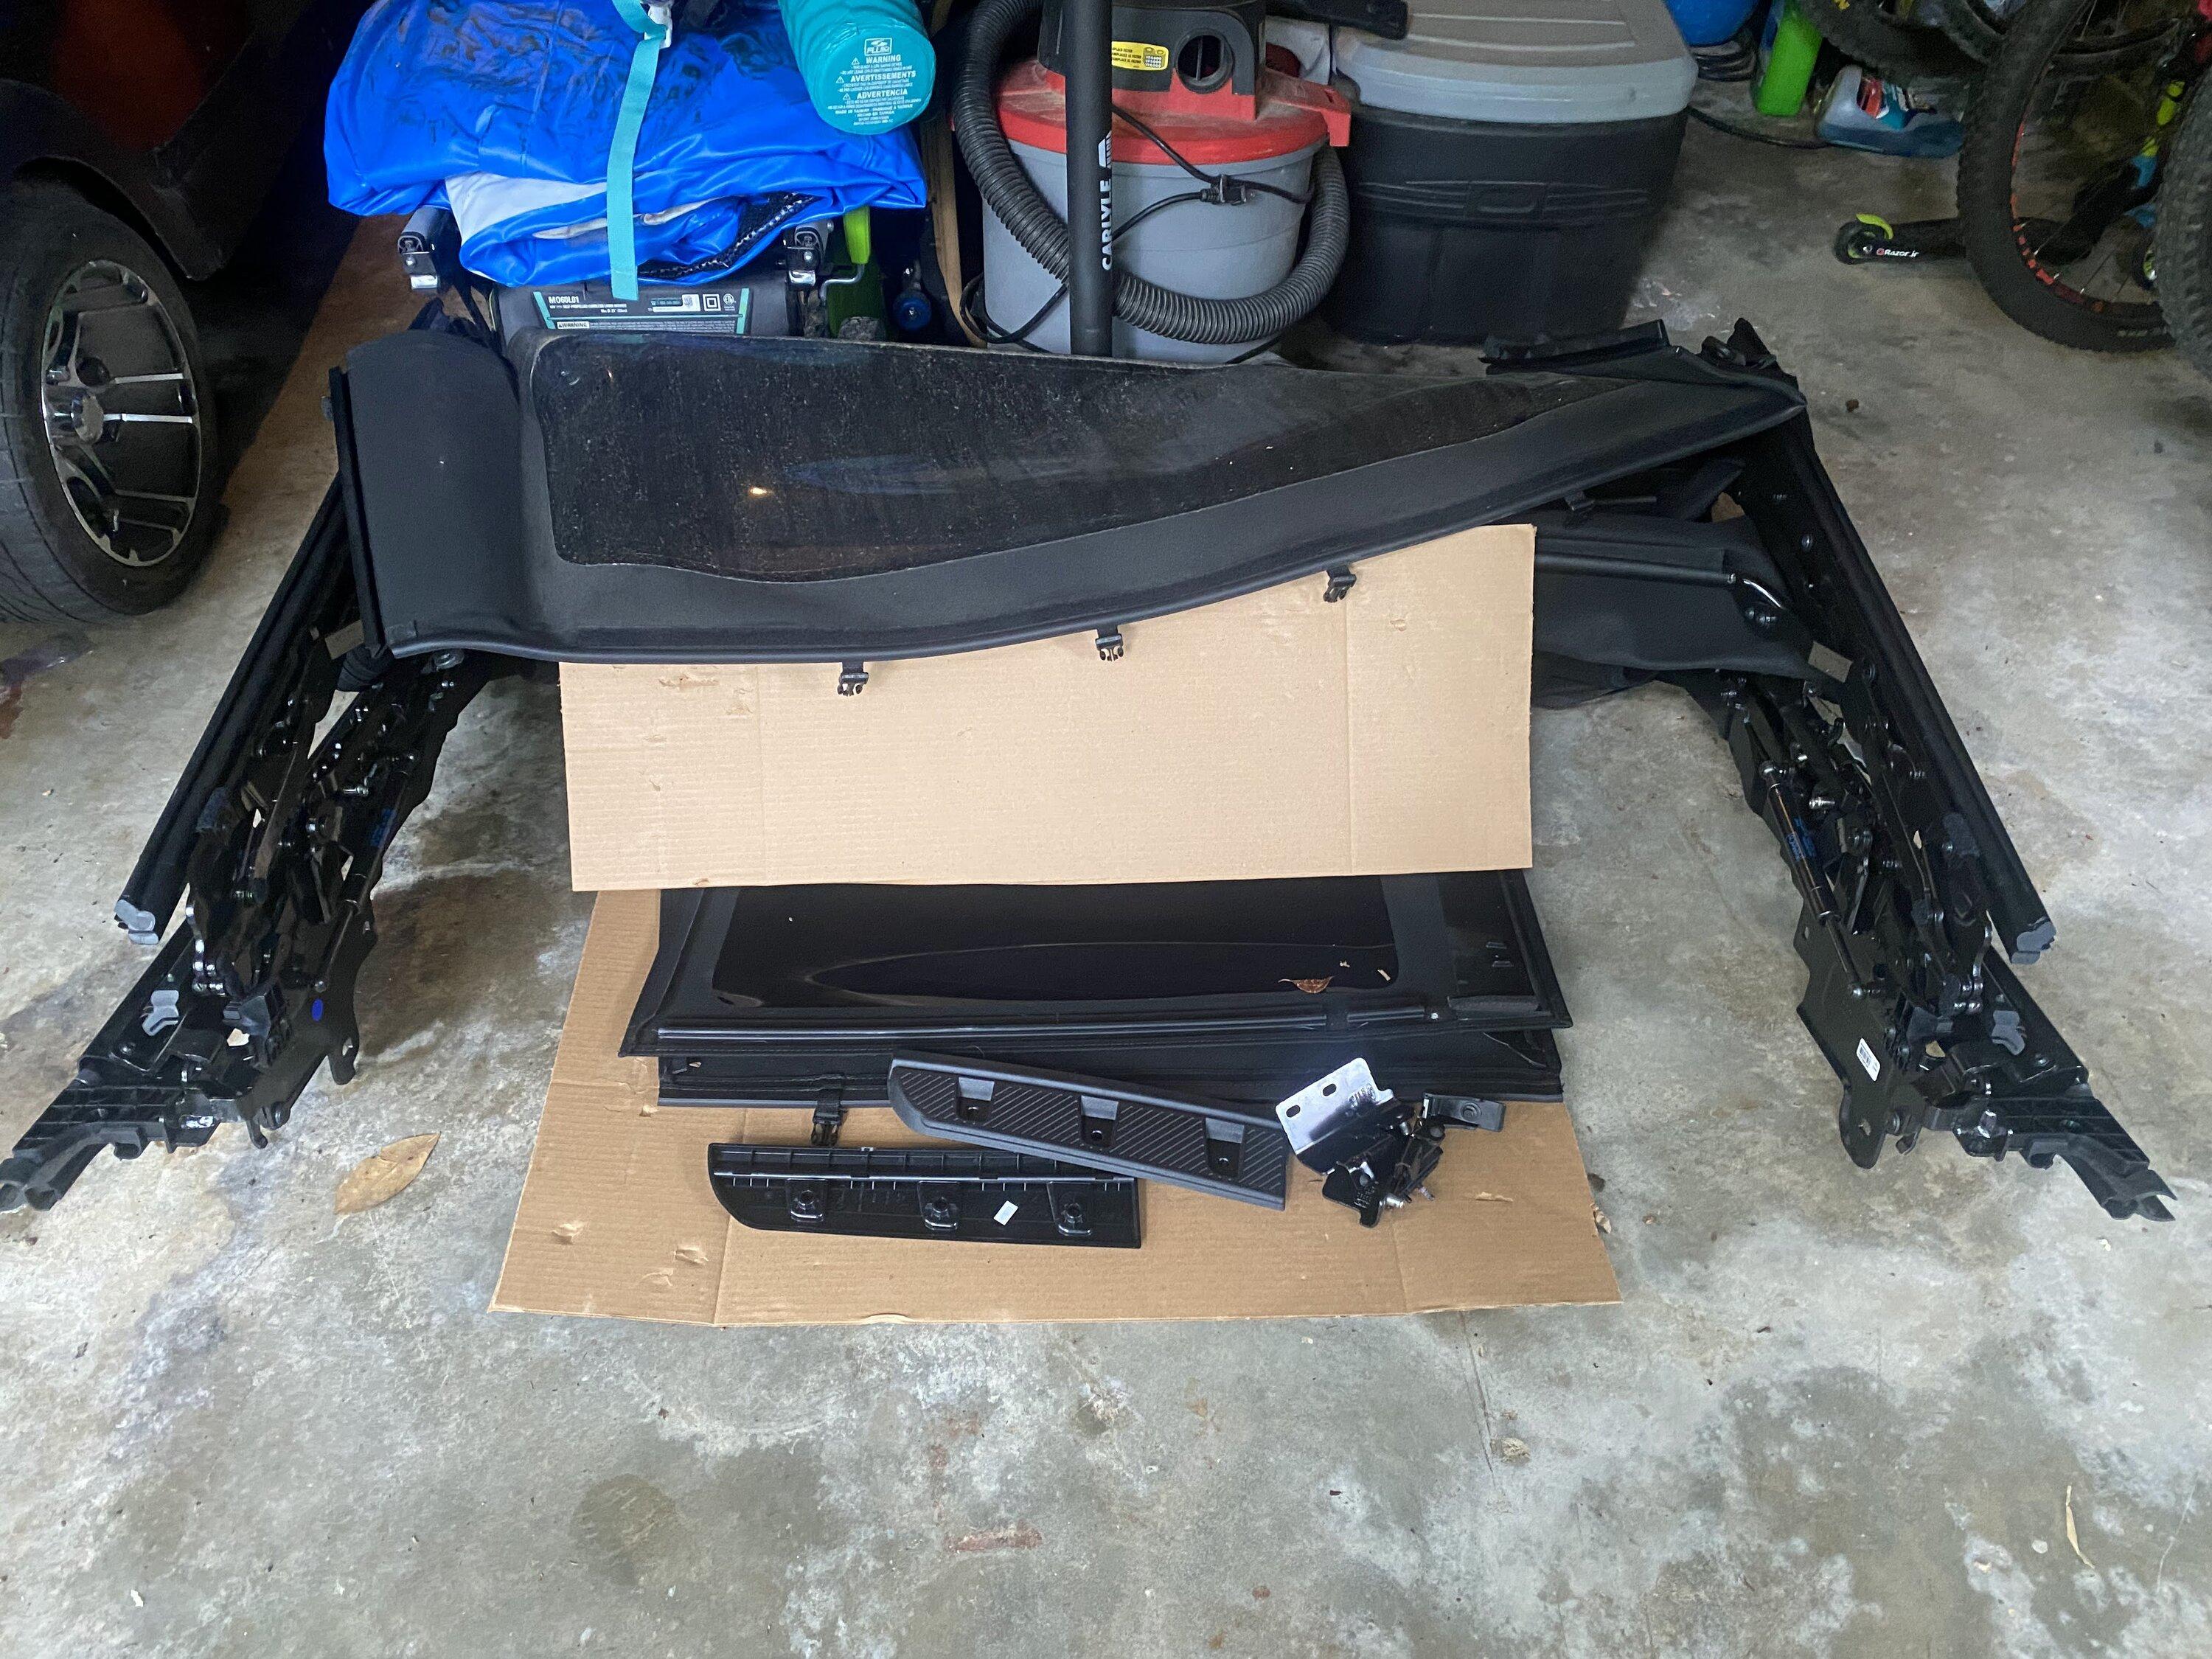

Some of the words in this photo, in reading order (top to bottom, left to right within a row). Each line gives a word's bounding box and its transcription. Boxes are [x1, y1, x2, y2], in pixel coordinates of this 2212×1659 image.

[866, 54, 901, 64] WARNING
[850, 70, 917, 83] AVERTISSEMENTS
[857, 88, 908, 100] ADVERTENCIA
[1099, 178, 1113, 271] CARLYLE
